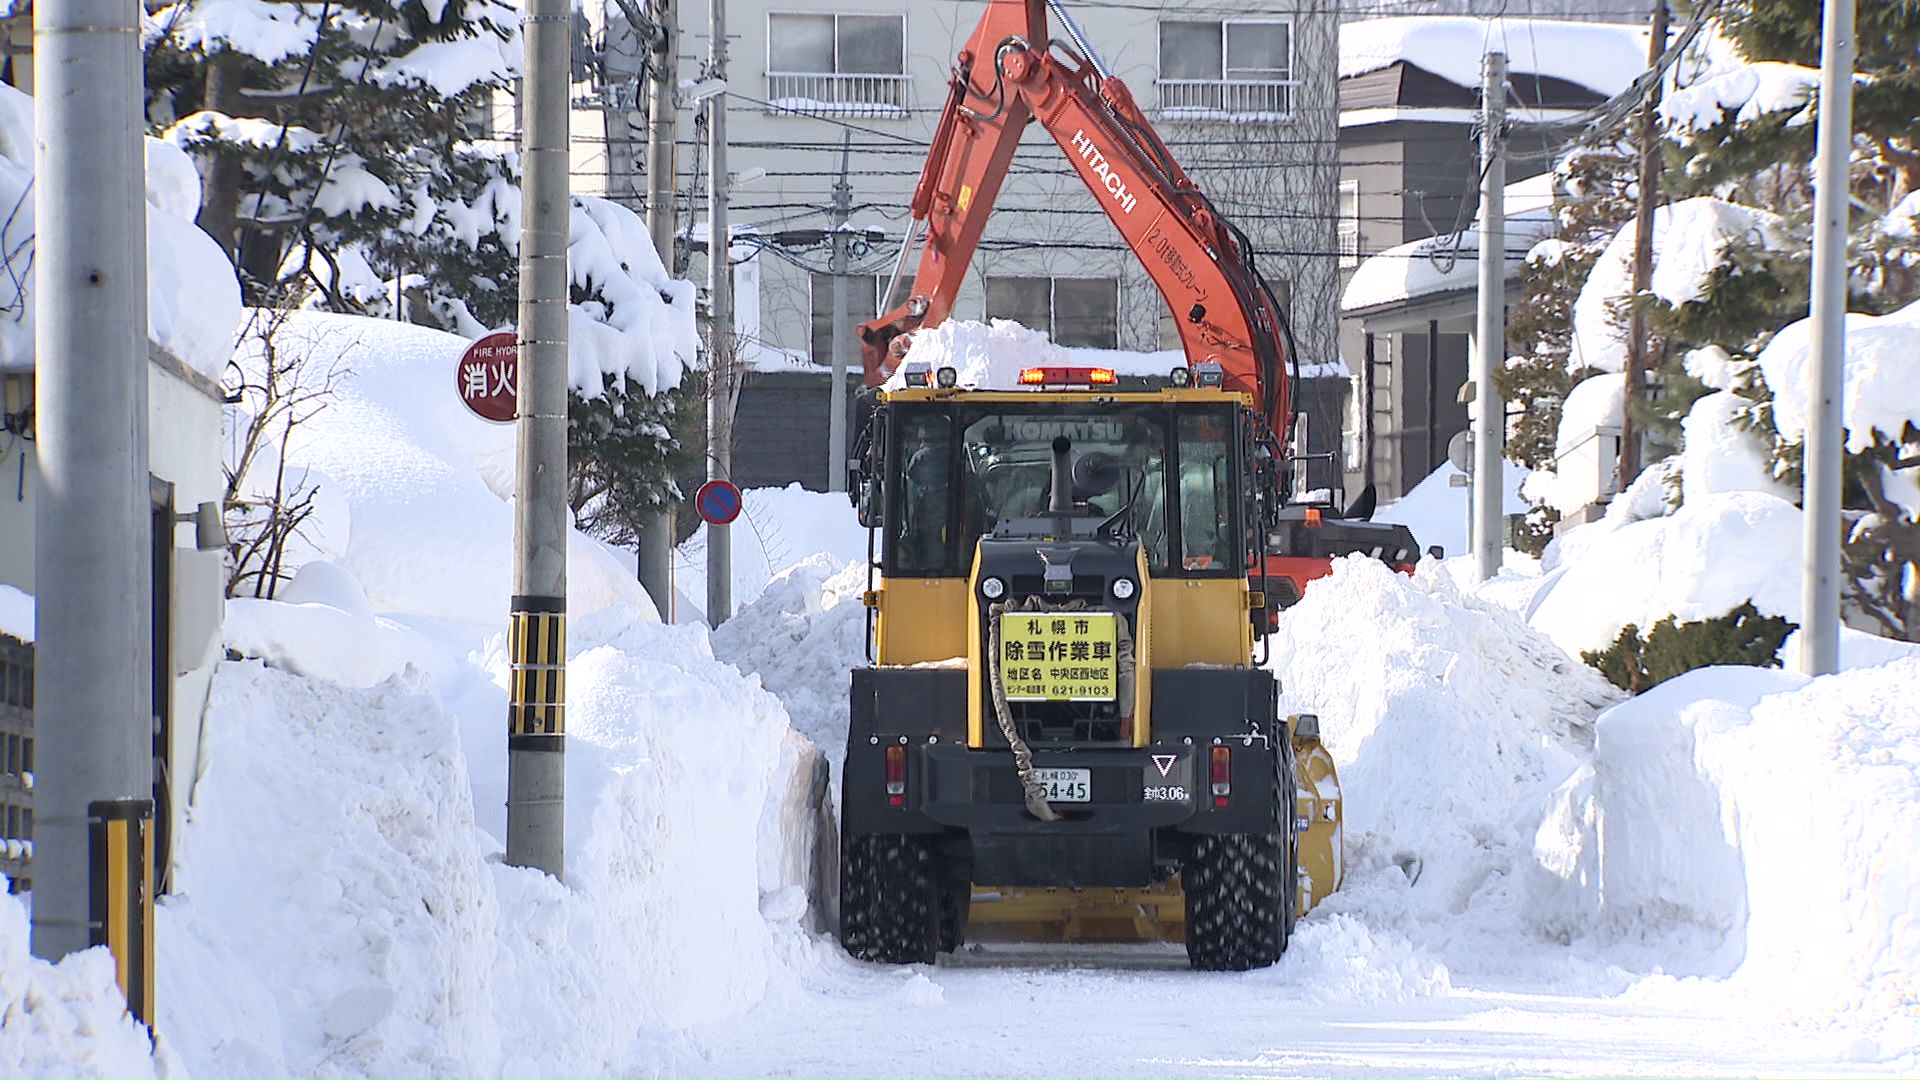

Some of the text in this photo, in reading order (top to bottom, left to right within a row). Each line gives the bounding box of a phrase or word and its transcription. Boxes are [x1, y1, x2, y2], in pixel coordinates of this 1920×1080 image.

[1071, 129, 1137, 215] HITACHI
[473, 345, 517, 358] FIRE HYDR
[1004, 421, 1124, 441] KOMATSU
[1027, 619, 1089, 635] 札幌市
[1005, 641, 1112, 662] 除雪作業車
[1007, 667, 1110, 681] 地区名 中央区西地区
[1039, 782, 1086, 799] 54-45
